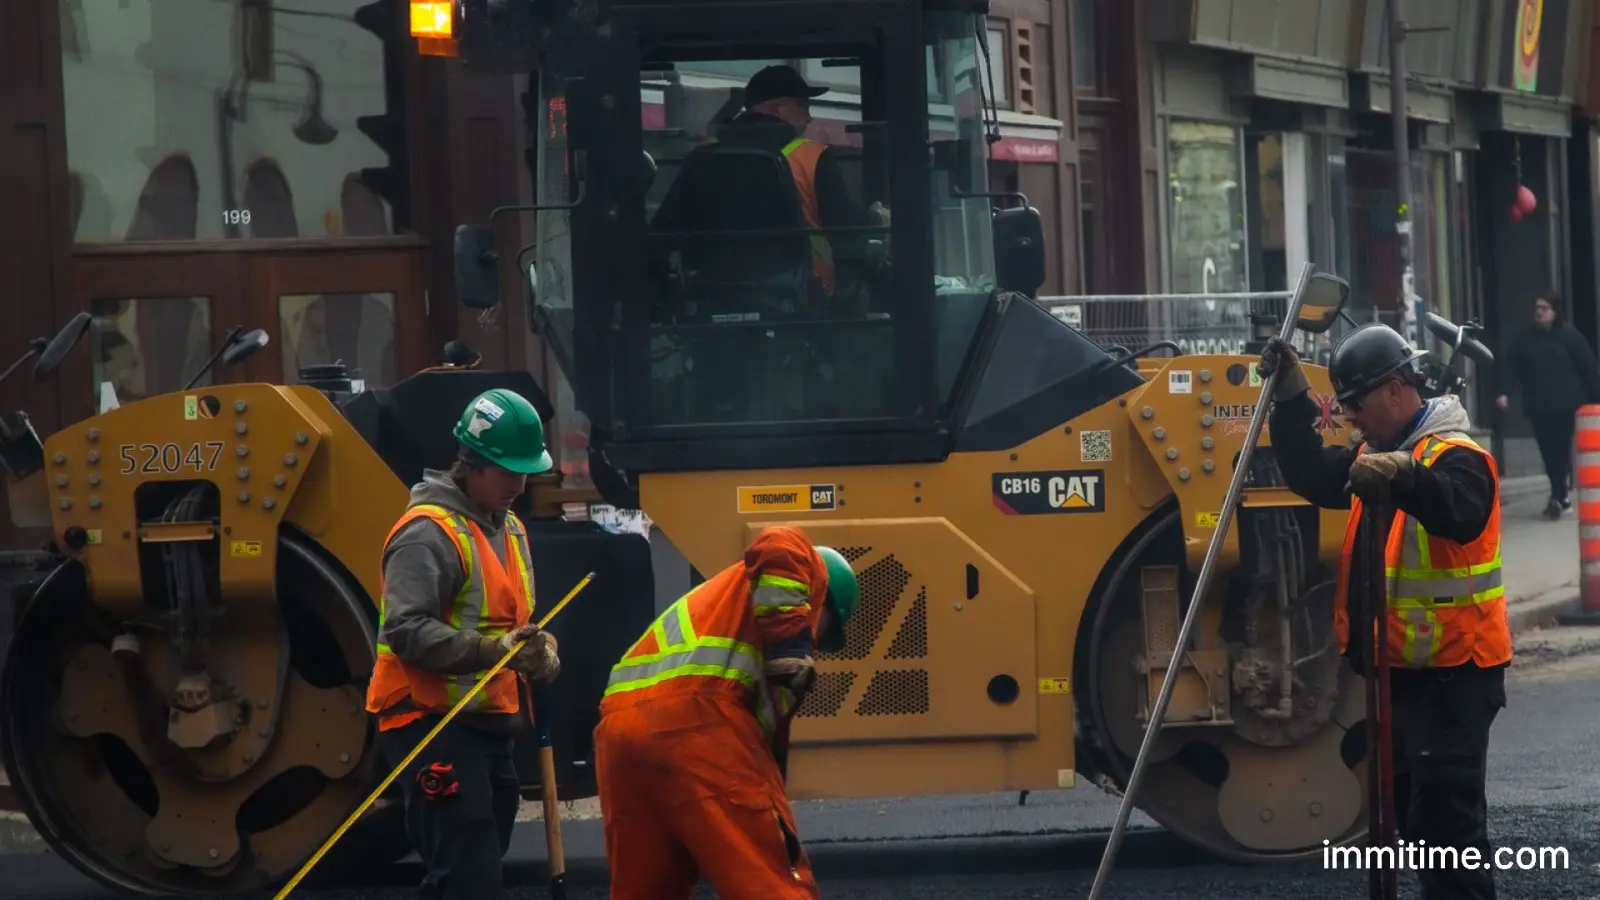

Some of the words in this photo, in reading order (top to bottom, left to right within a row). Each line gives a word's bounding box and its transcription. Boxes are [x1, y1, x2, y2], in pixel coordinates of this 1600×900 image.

[222, 209, 251, 225] 199
[120, 441, 225, 475] 52047
[752, 492, 798, 505] TOROMONT
[812, 490, 833, 504] CAT
[1001, 477, 1042, 495] CB16
[1048, 476, 1099, 509] CAT
